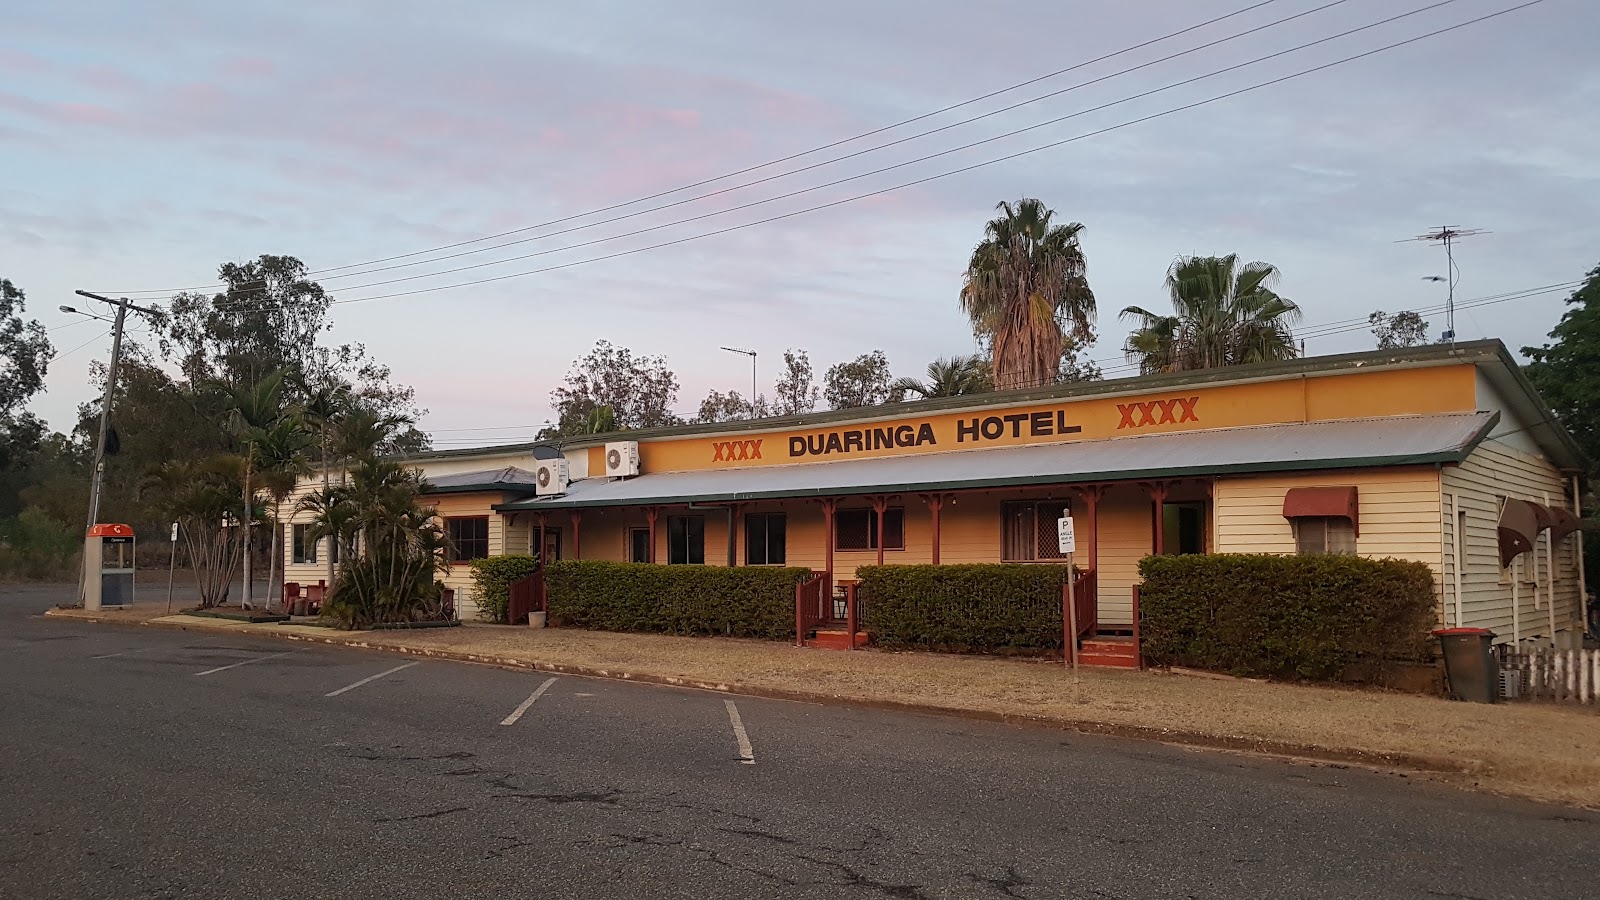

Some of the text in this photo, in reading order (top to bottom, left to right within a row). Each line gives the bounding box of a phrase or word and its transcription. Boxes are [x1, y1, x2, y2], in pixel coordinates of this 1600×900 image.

[1116, 396, 1199, 429] XXXX
[789, 410, 1082, 457] DUARINGA HOTEL
[712, 439, 762, 462] XXXX
[1062, 520, 1068, 529] P
